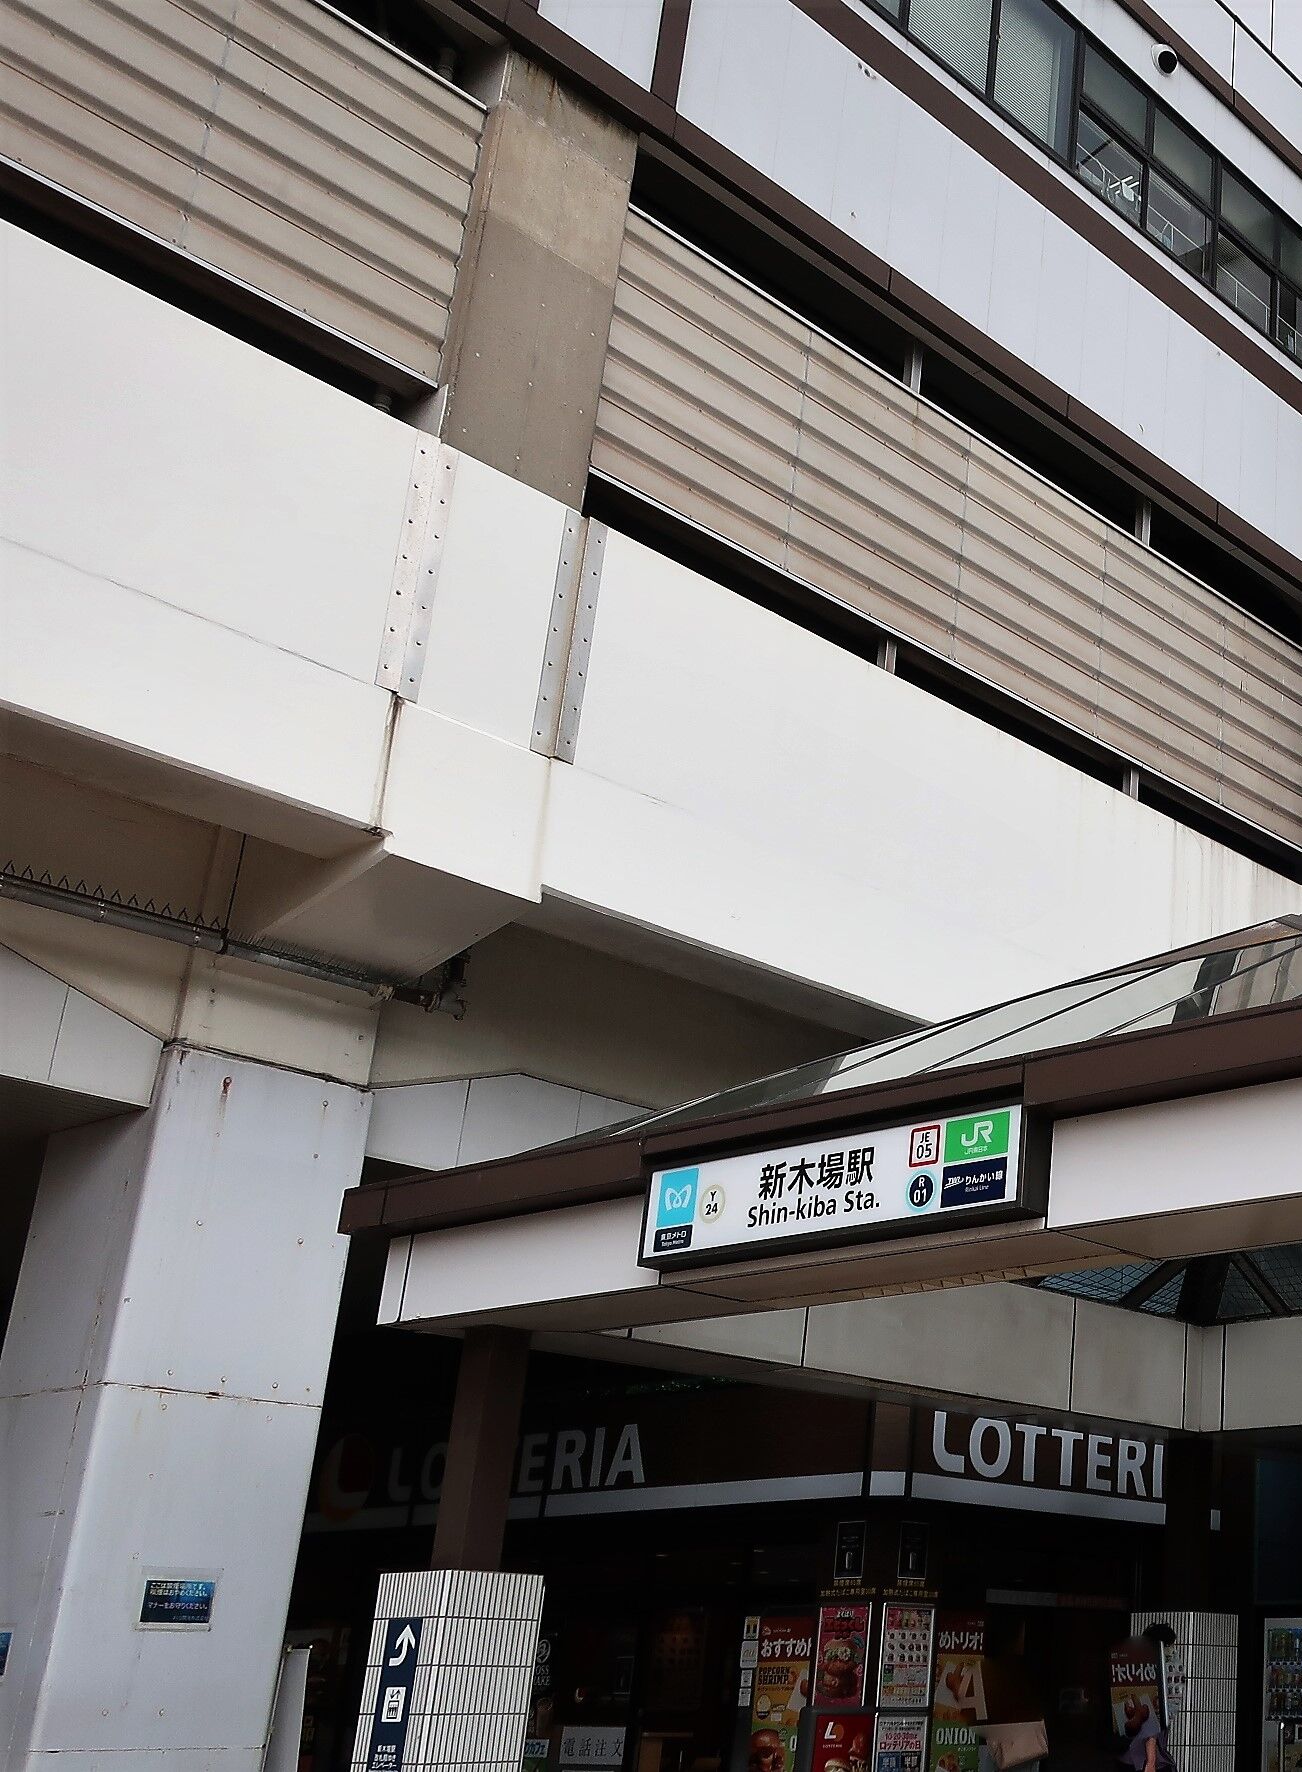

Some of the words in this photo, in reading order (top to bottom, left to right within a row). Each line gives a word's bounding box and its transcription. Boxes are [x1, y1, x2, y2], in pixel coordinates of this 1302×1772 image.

[920, 1132, 931, 1144] JE
[961, 1120, 994, 1147] JR
[916, 1143, 933, 1159] 05
[758, 1146, 875, 1201] 新木場駅
[918, 1177, 925, 1188] R
[710, 1190, 718, 1201] Y
[913, 1188, 927, 1203] 01
[705, 1203, 718, 1216] 24
[747, 1194, 837, 1228] Shin-kiba
[843, 1190, 880, 1213] Sta.
[387, 1422, 646, 1503] LOERIA
[936, 1727, 976, 1745] ONION
[563, 1737, 625, 1758] 電話注文
